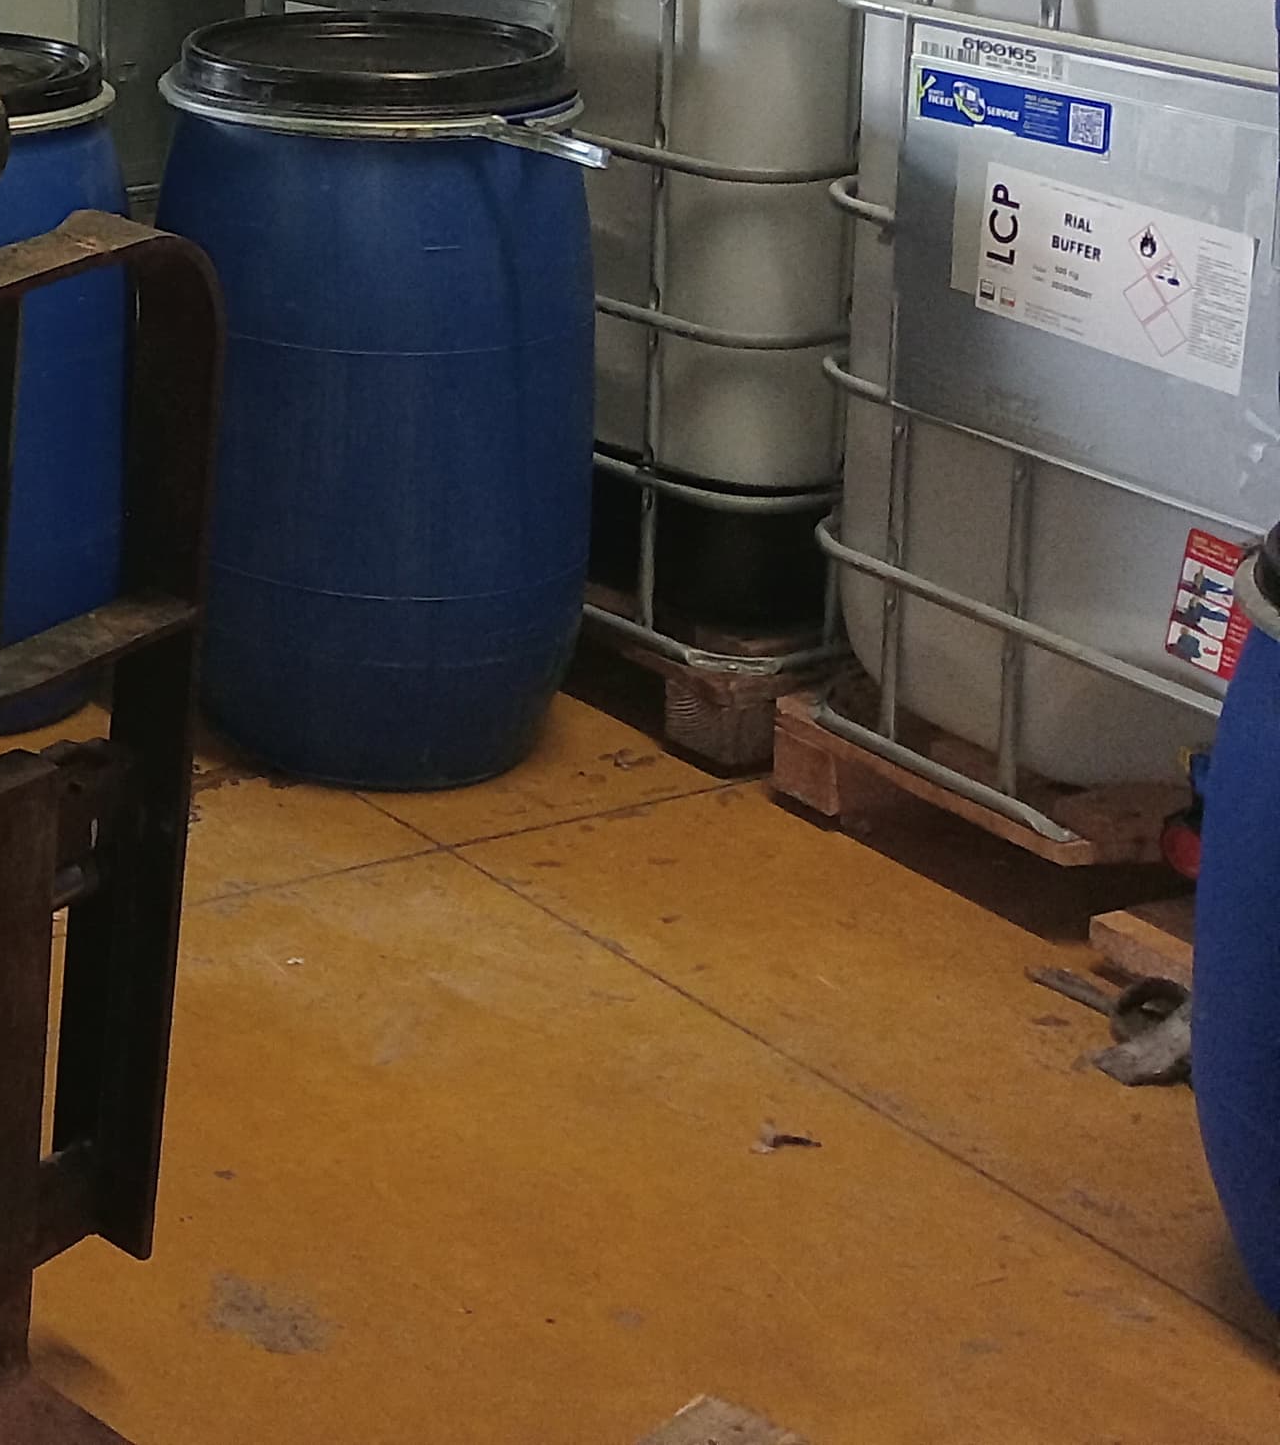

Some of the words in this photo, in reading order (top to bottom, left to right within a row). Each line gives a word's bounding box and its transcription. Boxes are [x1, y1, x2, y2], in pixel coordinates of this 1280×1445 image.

[962, 37, 1037, 63] 6100165
[987, 106, 1020, 121] SERVICE
[986, 183, 1021, 266] LCP
[1063, 212, 1094, 235] RIAL
[1050, 234, 1102, 263] BUFFER
